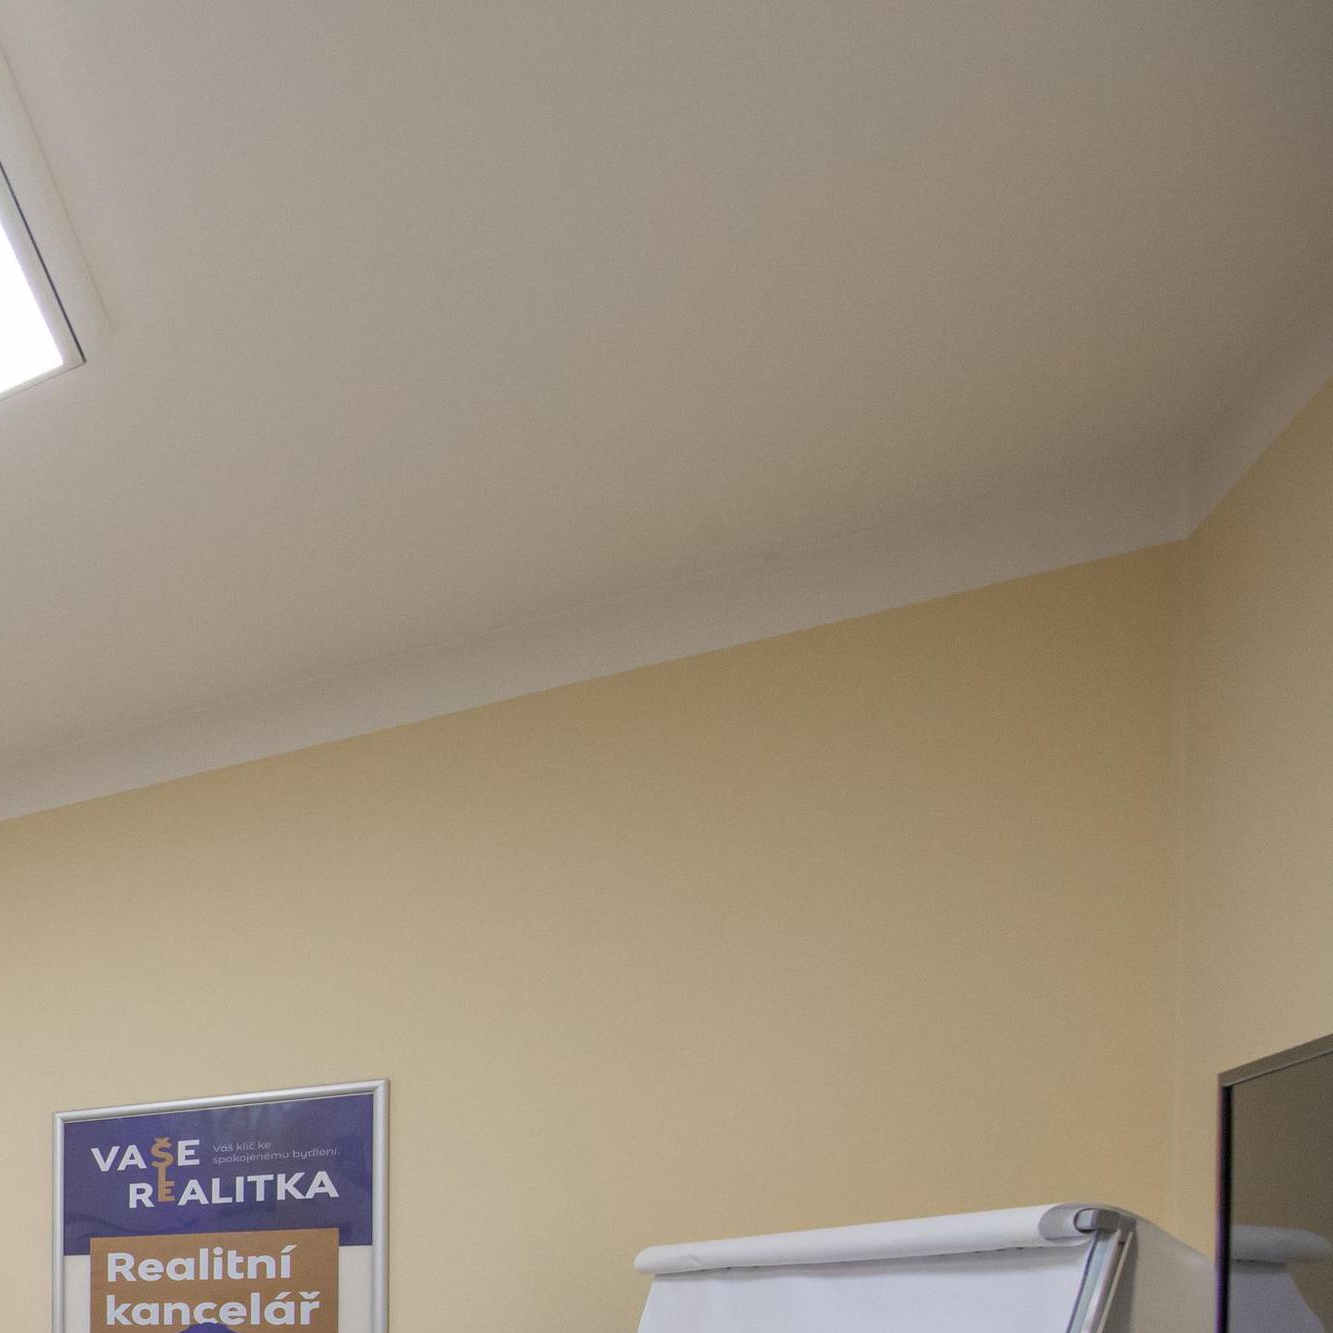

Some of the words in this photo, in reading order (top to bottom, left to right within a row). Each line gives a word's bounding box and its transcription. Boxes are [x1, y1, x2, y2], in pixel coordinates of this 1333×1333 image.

[90, 1137, 200, 1172] VAŠE
[129, 1170, 339, 1208] REALITKA
[106, 1244, 298, 1282] Realitní
[105, 1291, 321, 1326] kancelář
